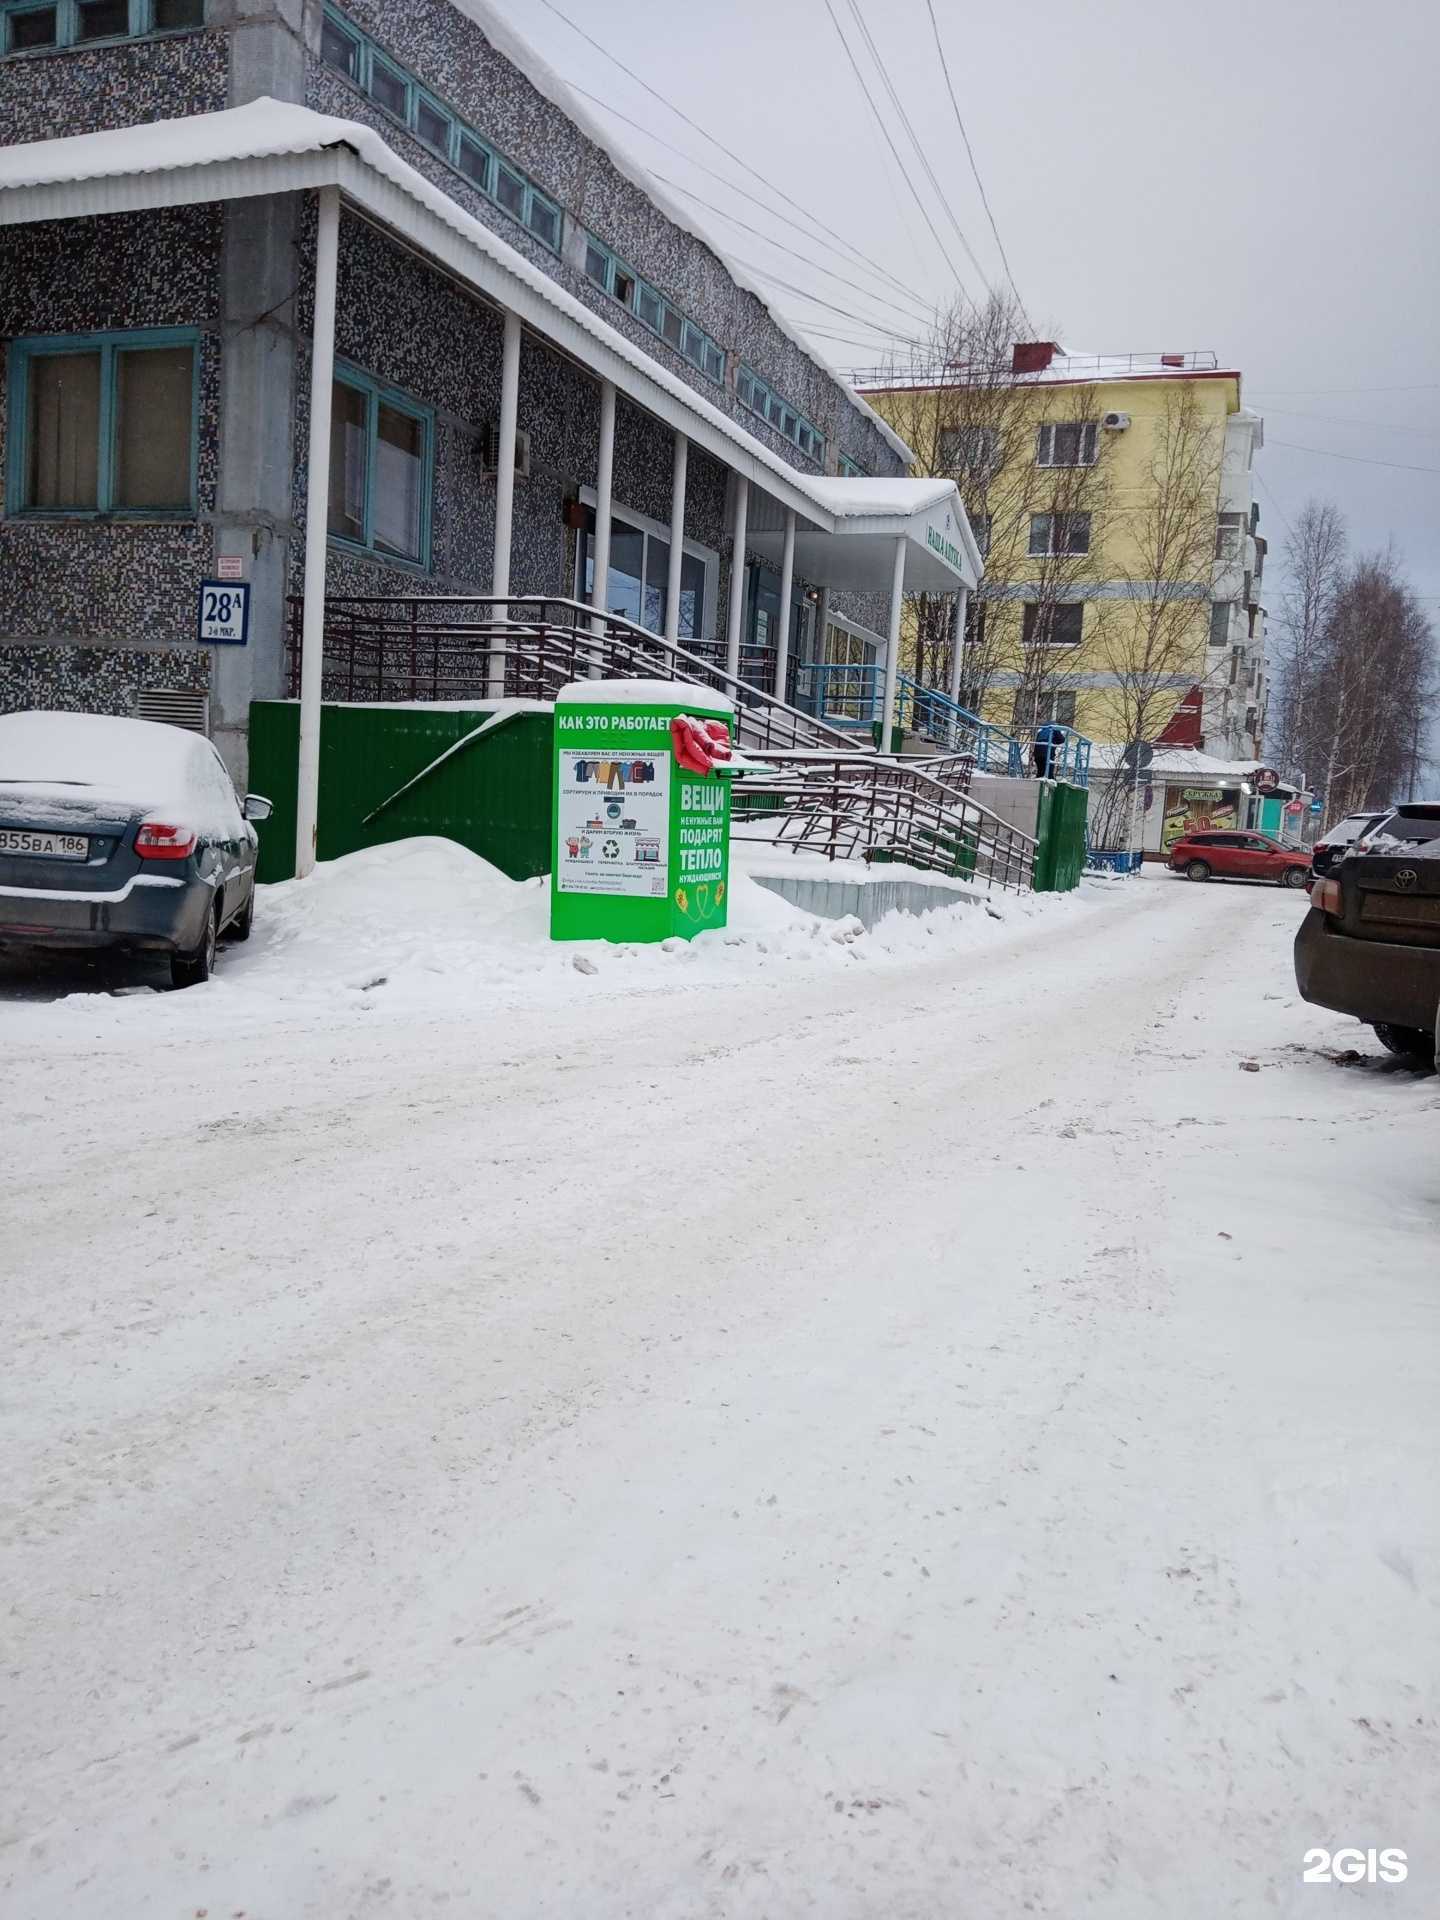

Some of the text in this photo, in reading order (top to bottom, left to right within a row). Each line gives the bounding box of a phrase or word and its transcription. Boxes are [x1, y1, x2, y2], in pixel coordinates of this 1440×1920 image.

[927, 525, 944, 557] НАША
[205, 592, 242, 623] 28А
[559, 716, 672, 731] КАК ЭТО РАБОТАЕТ
[681, 784, 724, 816] ВЕЩИ
[59, 837, 84, 851] 186
[680, 828, 723, 847] ПОДАРЯТ
[679, 848, 722, 871] ТЕПЛО
